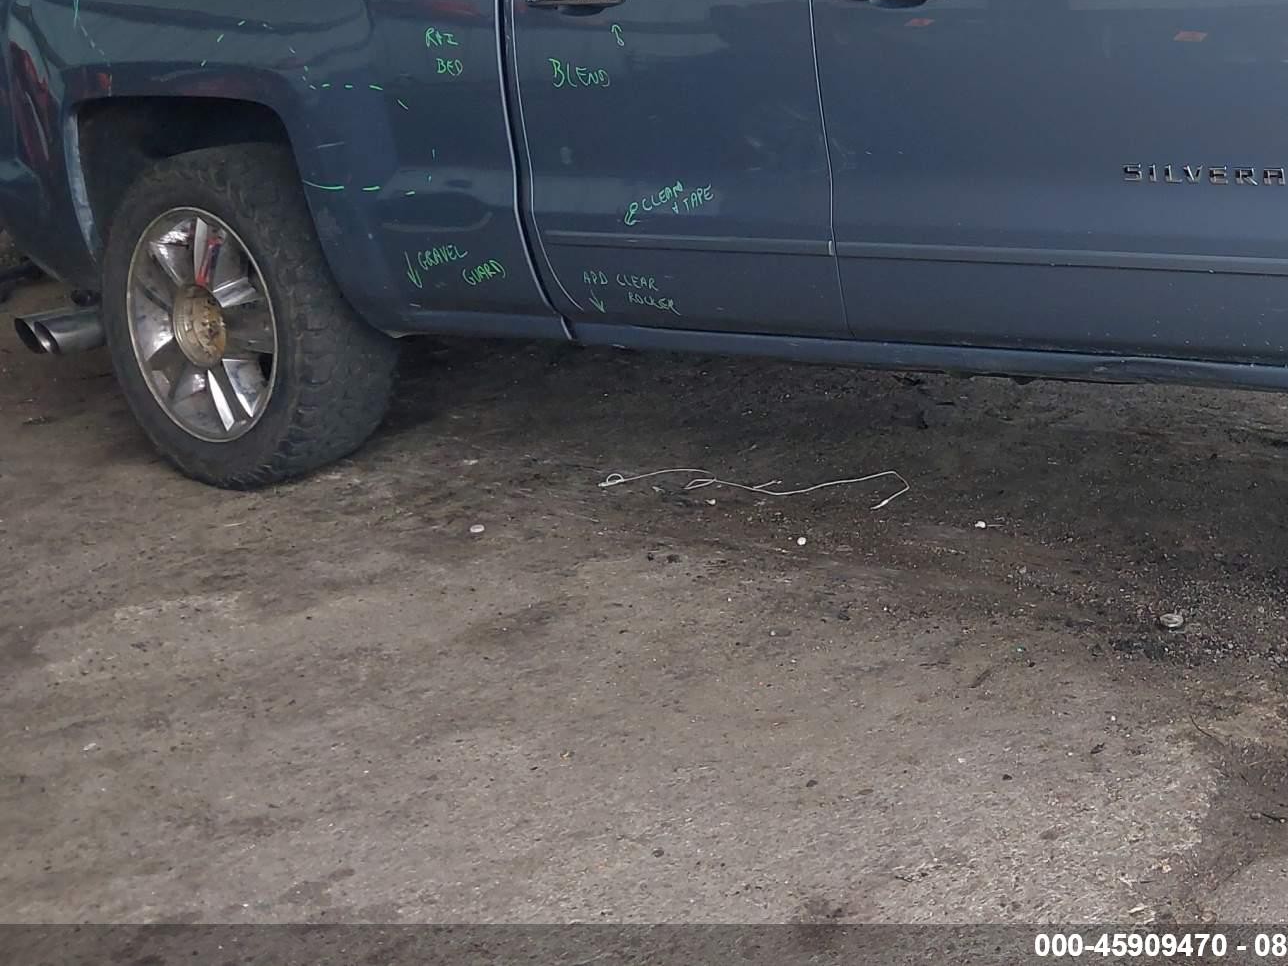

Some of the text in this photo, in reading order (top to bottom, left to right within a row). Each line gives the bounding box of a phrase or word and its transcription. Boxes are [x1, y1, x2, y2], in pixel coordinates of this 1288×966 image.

[436, 58, 463, 76] BED
[549, 58, 610, 88] BLEND
[683, 184, 714, 212] TAPE
[417, 245, 468, 271] GRAVEL
[462, 260, 506, 285] GUARD
[616, 274, 659, 291] CLEAR
